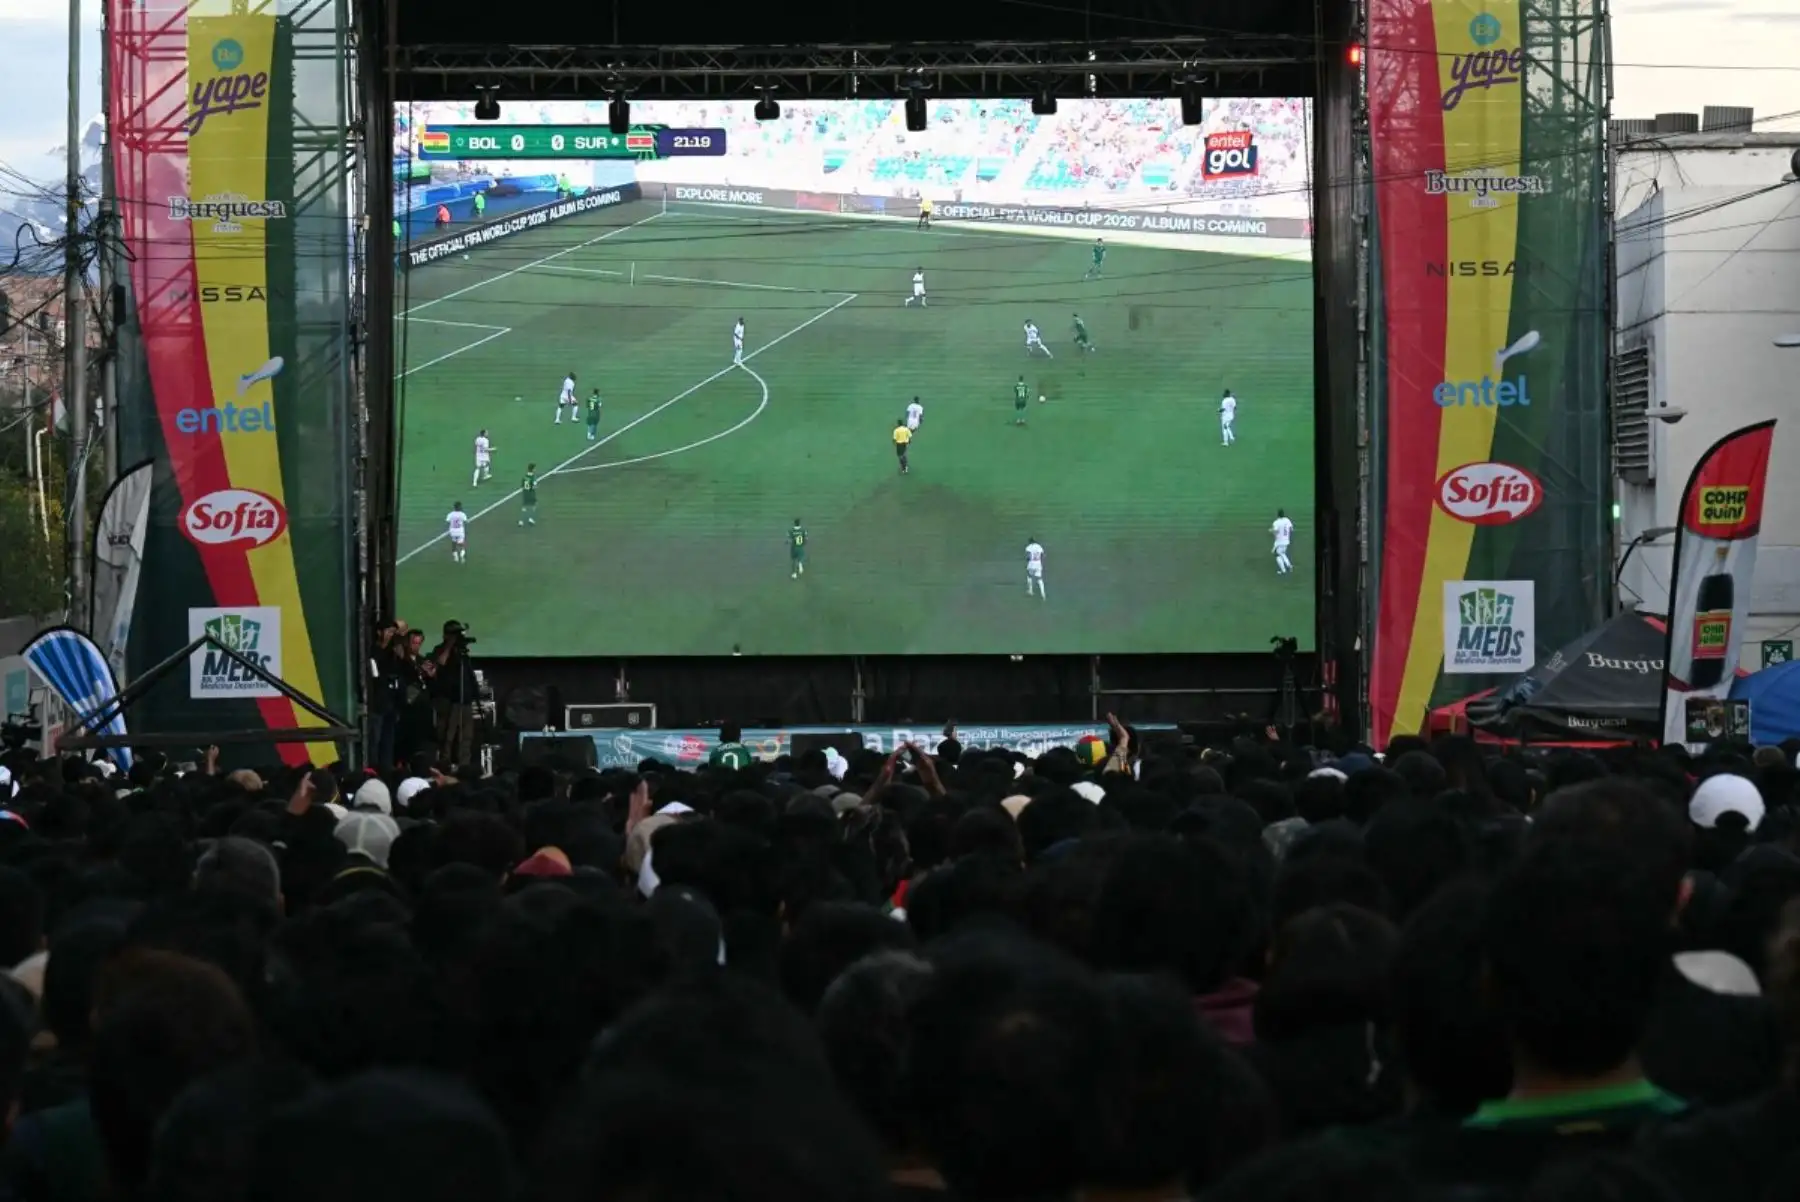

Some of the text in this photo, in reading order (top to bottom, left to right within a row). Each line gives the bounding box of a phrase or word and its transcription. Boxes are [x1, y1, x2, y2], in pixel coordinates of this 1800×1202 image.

[1440, 47, 1524, 111] yape
[184, 72, 268, 137] yape
[469, 134, 712, 151] BOL 0 0 SUR 21:19
[1210, 135, 1246, 148] entel
[1209, 147, 1251, 174] gol
[676, 187, 763, 204] EXPLORE MORE
[1425, 170, 1543, 196] Burguesa
[168, 196, 286, 222] Burguesa
[943, 205, 996, 219] OFFICIAL
[1000, 208, 1026, 222] FIFA
[1026, 210, 1074, 224] WORLD
[1075, 212, 1104, 226] CUP
[1142, 217, 1191, 231] ALBUM
[1193, 219, 1206, 232] IS
[1207, 219, 1267, 234] COMING
[410, 250, 428, 265] THE
[428, 238, 465, 259] OFFICIAL
[465, 232, 482, 247] FIFA
[482, 222, 511, 242] WORLD
[511, 217, 527, 232] CUP
[550, 201, 576, 220] ALBUM
[576, 198, 586, 212] IS
[585, 190, 622, 209] COMING
[1432, 375, 1531, 407] entel
[176, 401, 276, 433] entel
[1448, 476, 1529, 510] Sofía
[192, 502, 274, 537] Sofía
[1585, 652, 1665, 674] Burgu
